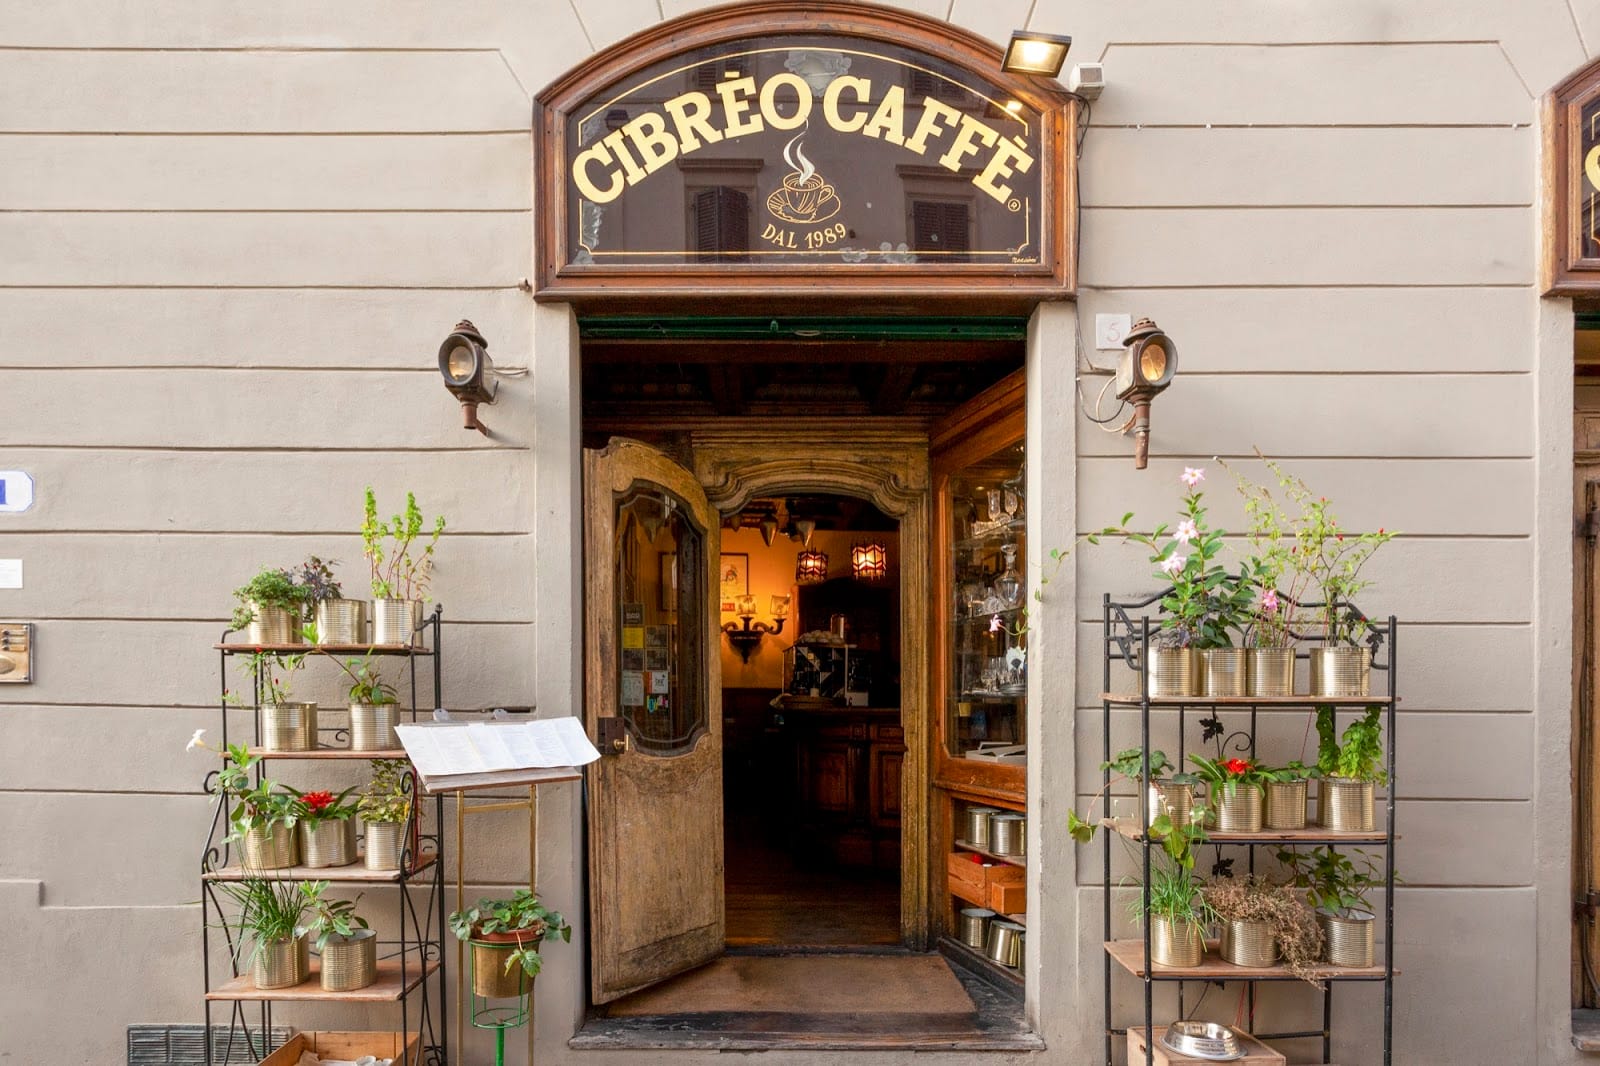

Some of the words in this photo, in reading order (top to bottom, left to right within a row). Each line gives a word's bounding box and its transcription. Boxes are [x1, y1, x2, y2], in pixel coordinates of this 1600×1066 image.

[572, 71, 813, 204] CIBRÈO
[823, 75, 1034, 204] CAFFÈ
[760, 223, 798, 249] DAL
[804, 223, 846, 249] 1989
